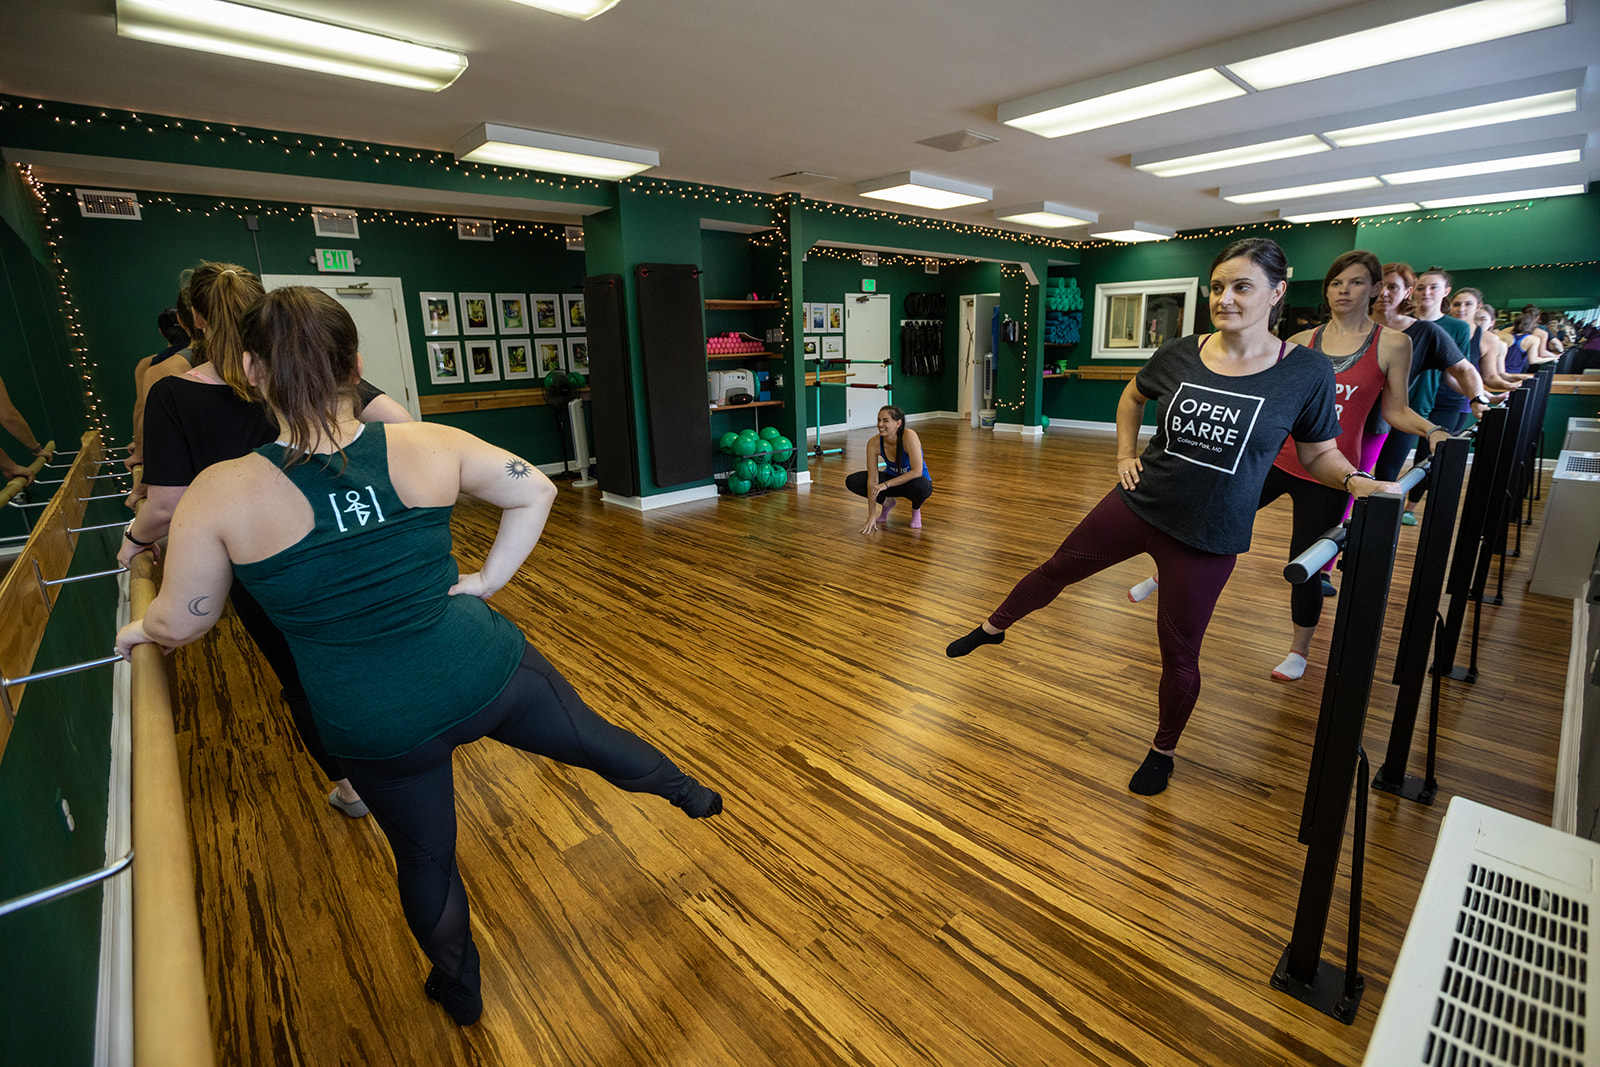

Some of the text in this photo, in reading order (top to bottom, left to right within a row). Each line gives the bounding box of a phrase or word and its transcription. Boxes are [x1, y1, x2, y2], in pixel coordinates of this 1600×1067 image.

[322, 250, 349, 269] EXIT
[1179, 398, 1241, 425] OPEN
[1171, 415, 1239, 446] BARRE
[1176, 436, 1223, 453] College Park, MD
